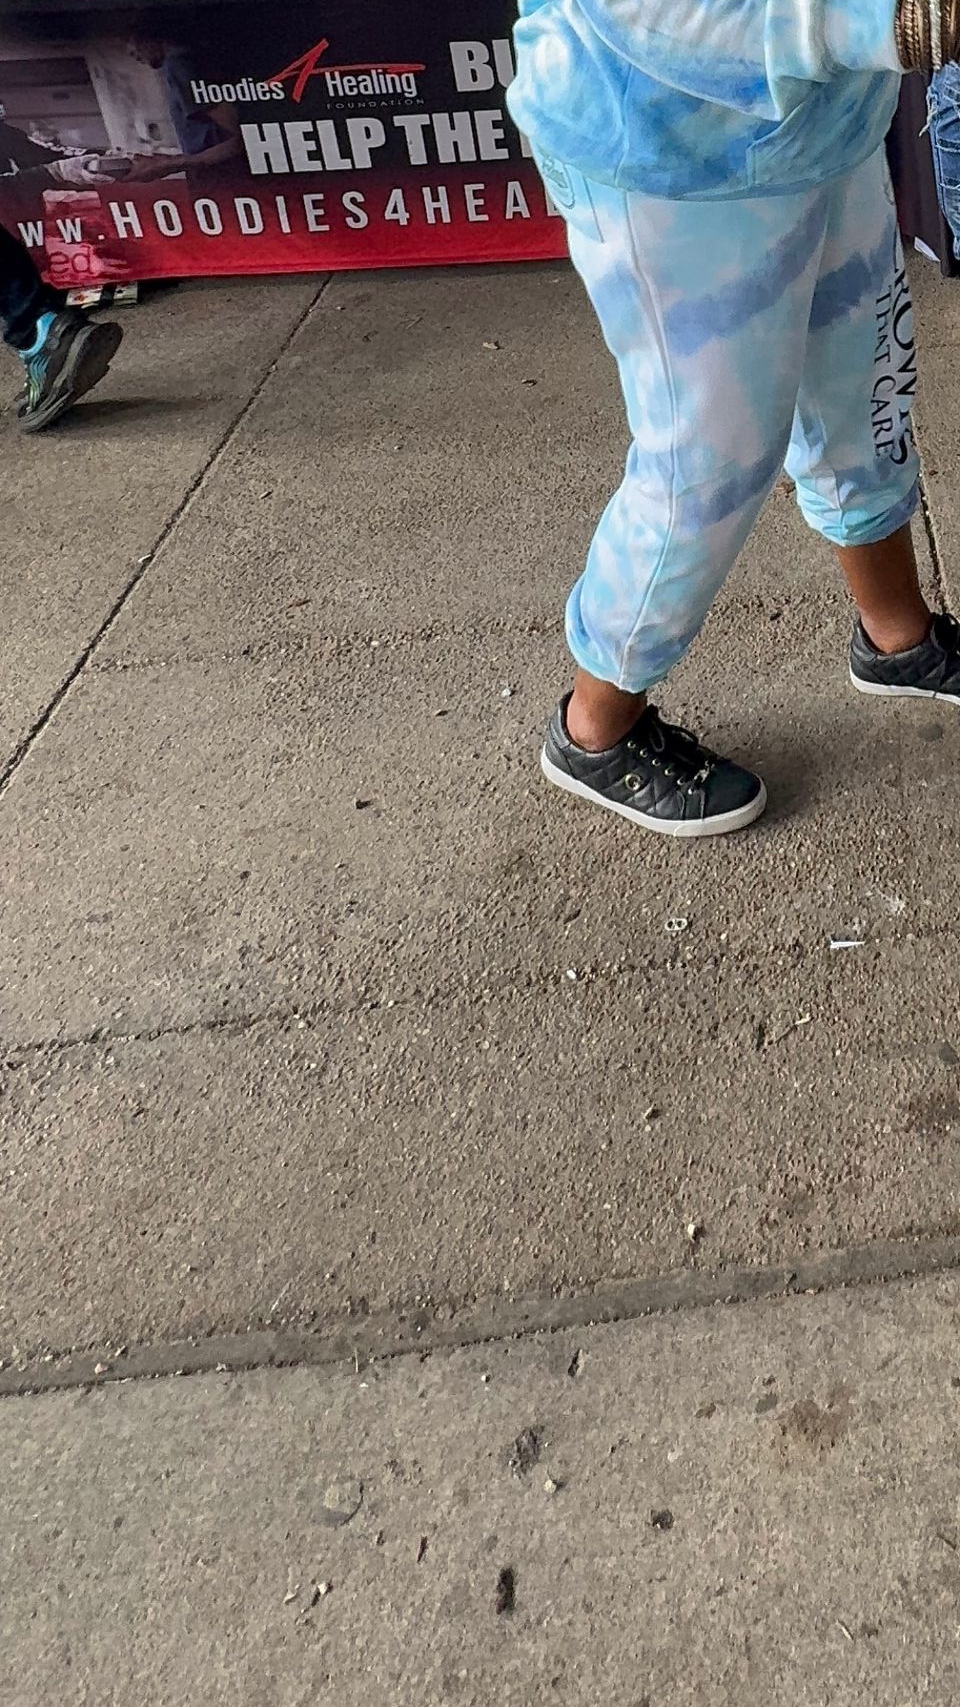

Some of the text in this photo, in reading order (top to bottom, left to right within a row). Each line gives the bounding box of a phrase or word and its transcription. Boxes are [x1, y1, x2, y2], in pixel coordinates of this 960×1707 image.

[190, 77, 285, 104] Hoodies
[325, 67, 419, 98] Healing
[326, 97, 425, 110] FOUNDATION
[240, 117, 387, 175] HELP
[393, 109, 509, 166] THE
